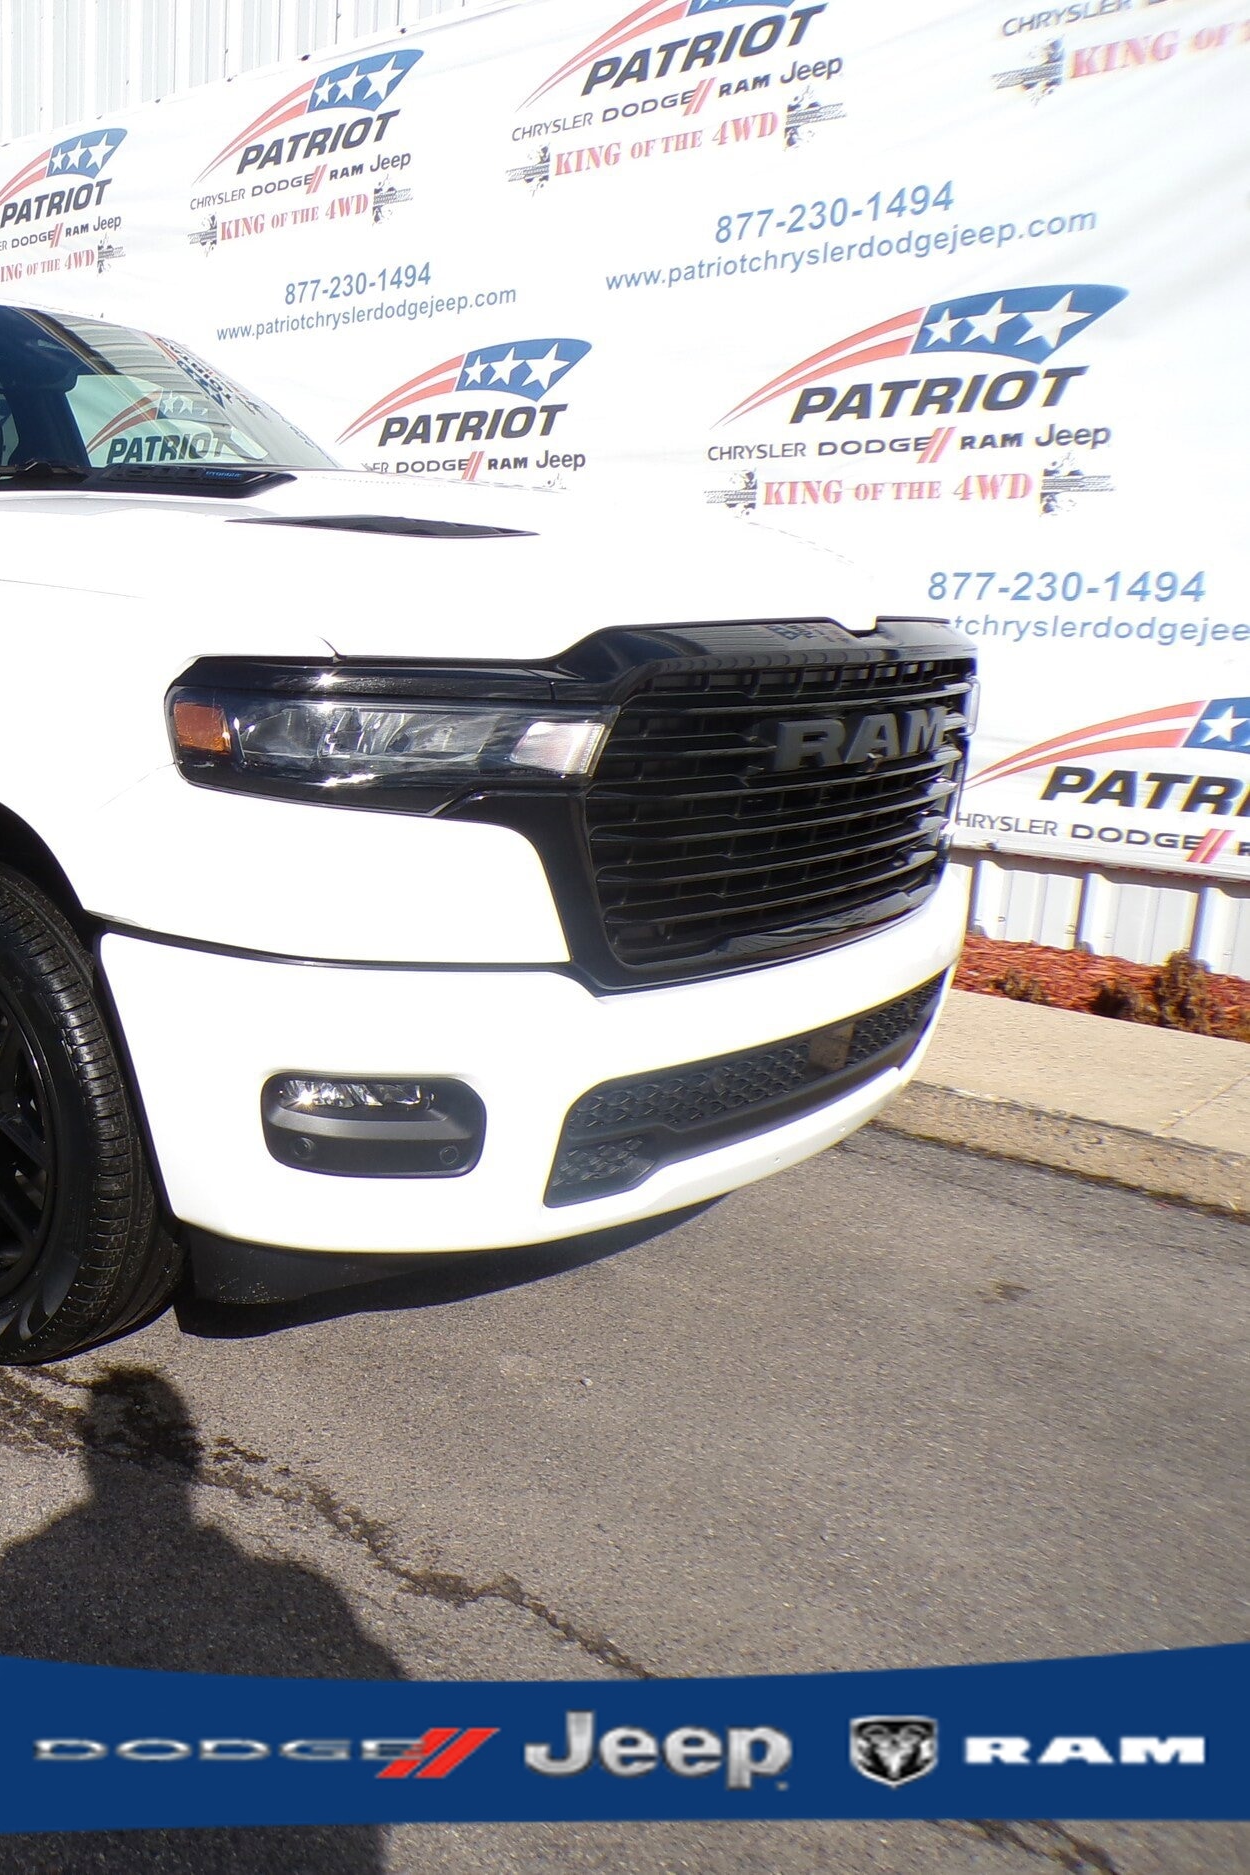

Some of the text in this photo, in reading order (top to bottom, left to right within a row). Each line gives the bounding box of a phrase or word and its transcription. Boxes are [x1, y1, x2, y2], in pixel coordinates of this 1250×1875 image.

[580, 2, 829, 96] PATRIOT
[1069, 28, 1181, 79] KING
[1193, 22, 1235, 50] OF
[511, 56, 844, 141] CHRYSLER DODGE RAM Jeep
[236, 109, 401, 175] PATRIOT
[554, 112, 779, 176] KING OF THE 4WD
[0, 178, 112, 229] PATRIOT
[190, 152, 411, 210] CHRYSLER DODGE RAM Jeep
[11, 230, 55, 249] DODGE
[65, 223, 89, 237] RAM
[93, 216, 121, 231] Jeep
[220, 194, 368, 241] KING OF THE 4WD
[715, 180, 955, 244] 877-230-1494
[26, 263, 39, 276] OF
[40, 259, 60, 274] THE
[64, 249, 95, 270] 4WD
[605, 209, 1097, 291] www.patriotchryslerdodgejeep.com
[285, 261, 431, 305] 877-230-1494
[216, 288, 516, 341] www.patriotchryslerdodgejeep.com
[788, 365, 1090, 425] PATRIOT
[106, 432, 227, 464] PATRIOT
[377, 404, 568, 447] PATRIOT
[707, 423, 1112, 461] CHRYSLER DODGE RAM Jeep
[396, 459, 470, 474] DODGE
[487, 456, 528, 470] RAM
[536, 449, 586, 471] Jeep
[763, 472, 1033, 507] KING OF THE 4WD
[927, 570, 1206, 602] 877-230-1494
[954, 615, 1250, 647] tchryslerdodgejee
[772, 705, 948, 772] RAM
[956, 812, 1204, 850] HRYSLER DODGE
